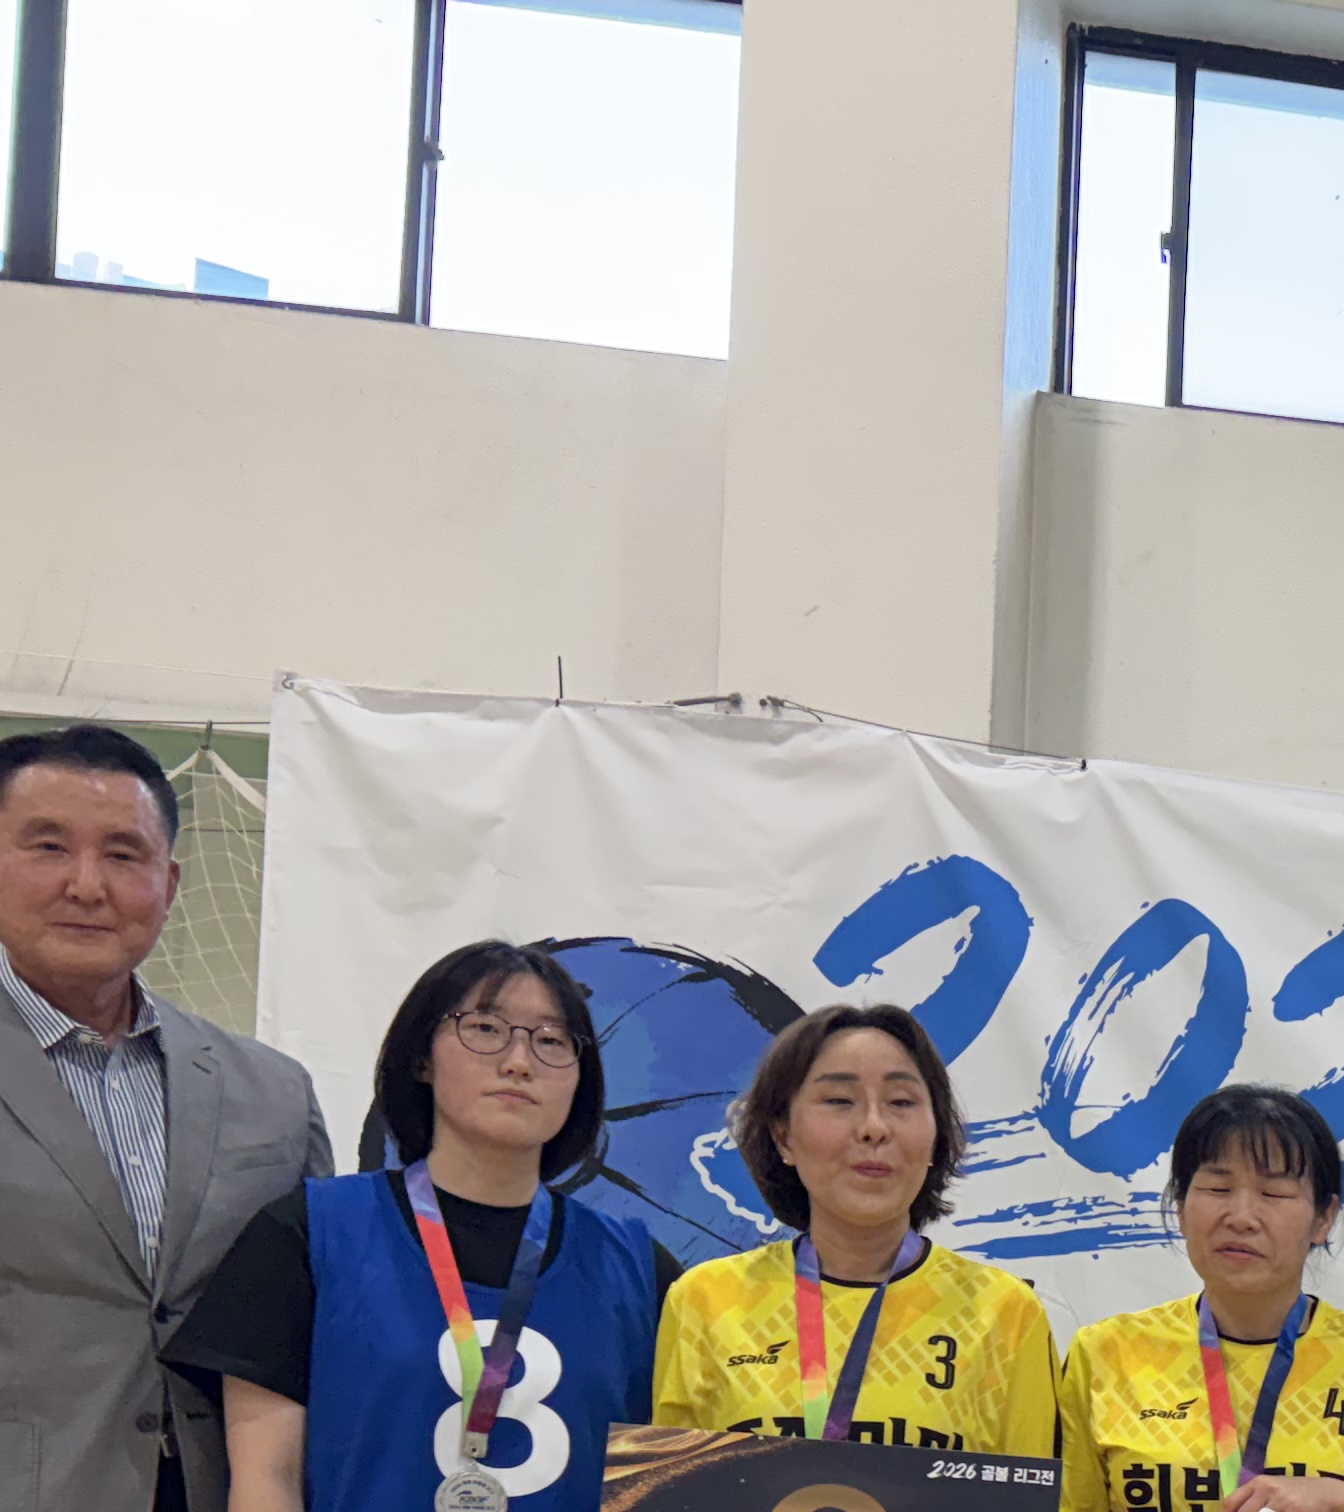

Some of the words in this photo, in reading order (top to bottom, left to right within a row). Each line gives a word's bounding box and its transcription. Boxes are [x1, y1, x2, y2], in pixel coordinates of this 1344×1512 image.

[727, 1353, 779, 1367] ssaka
[925, 1335, 958, 1390] 3
[434, 1319, 570, 1498] 8
[1139, 1409, 1188, 1421] ssaka
[926, 1460, 977, 1480] 2026
[981, 1464, 1009, 1483] 골볼
[1013, 1468, 1055, 1486] 리그전
